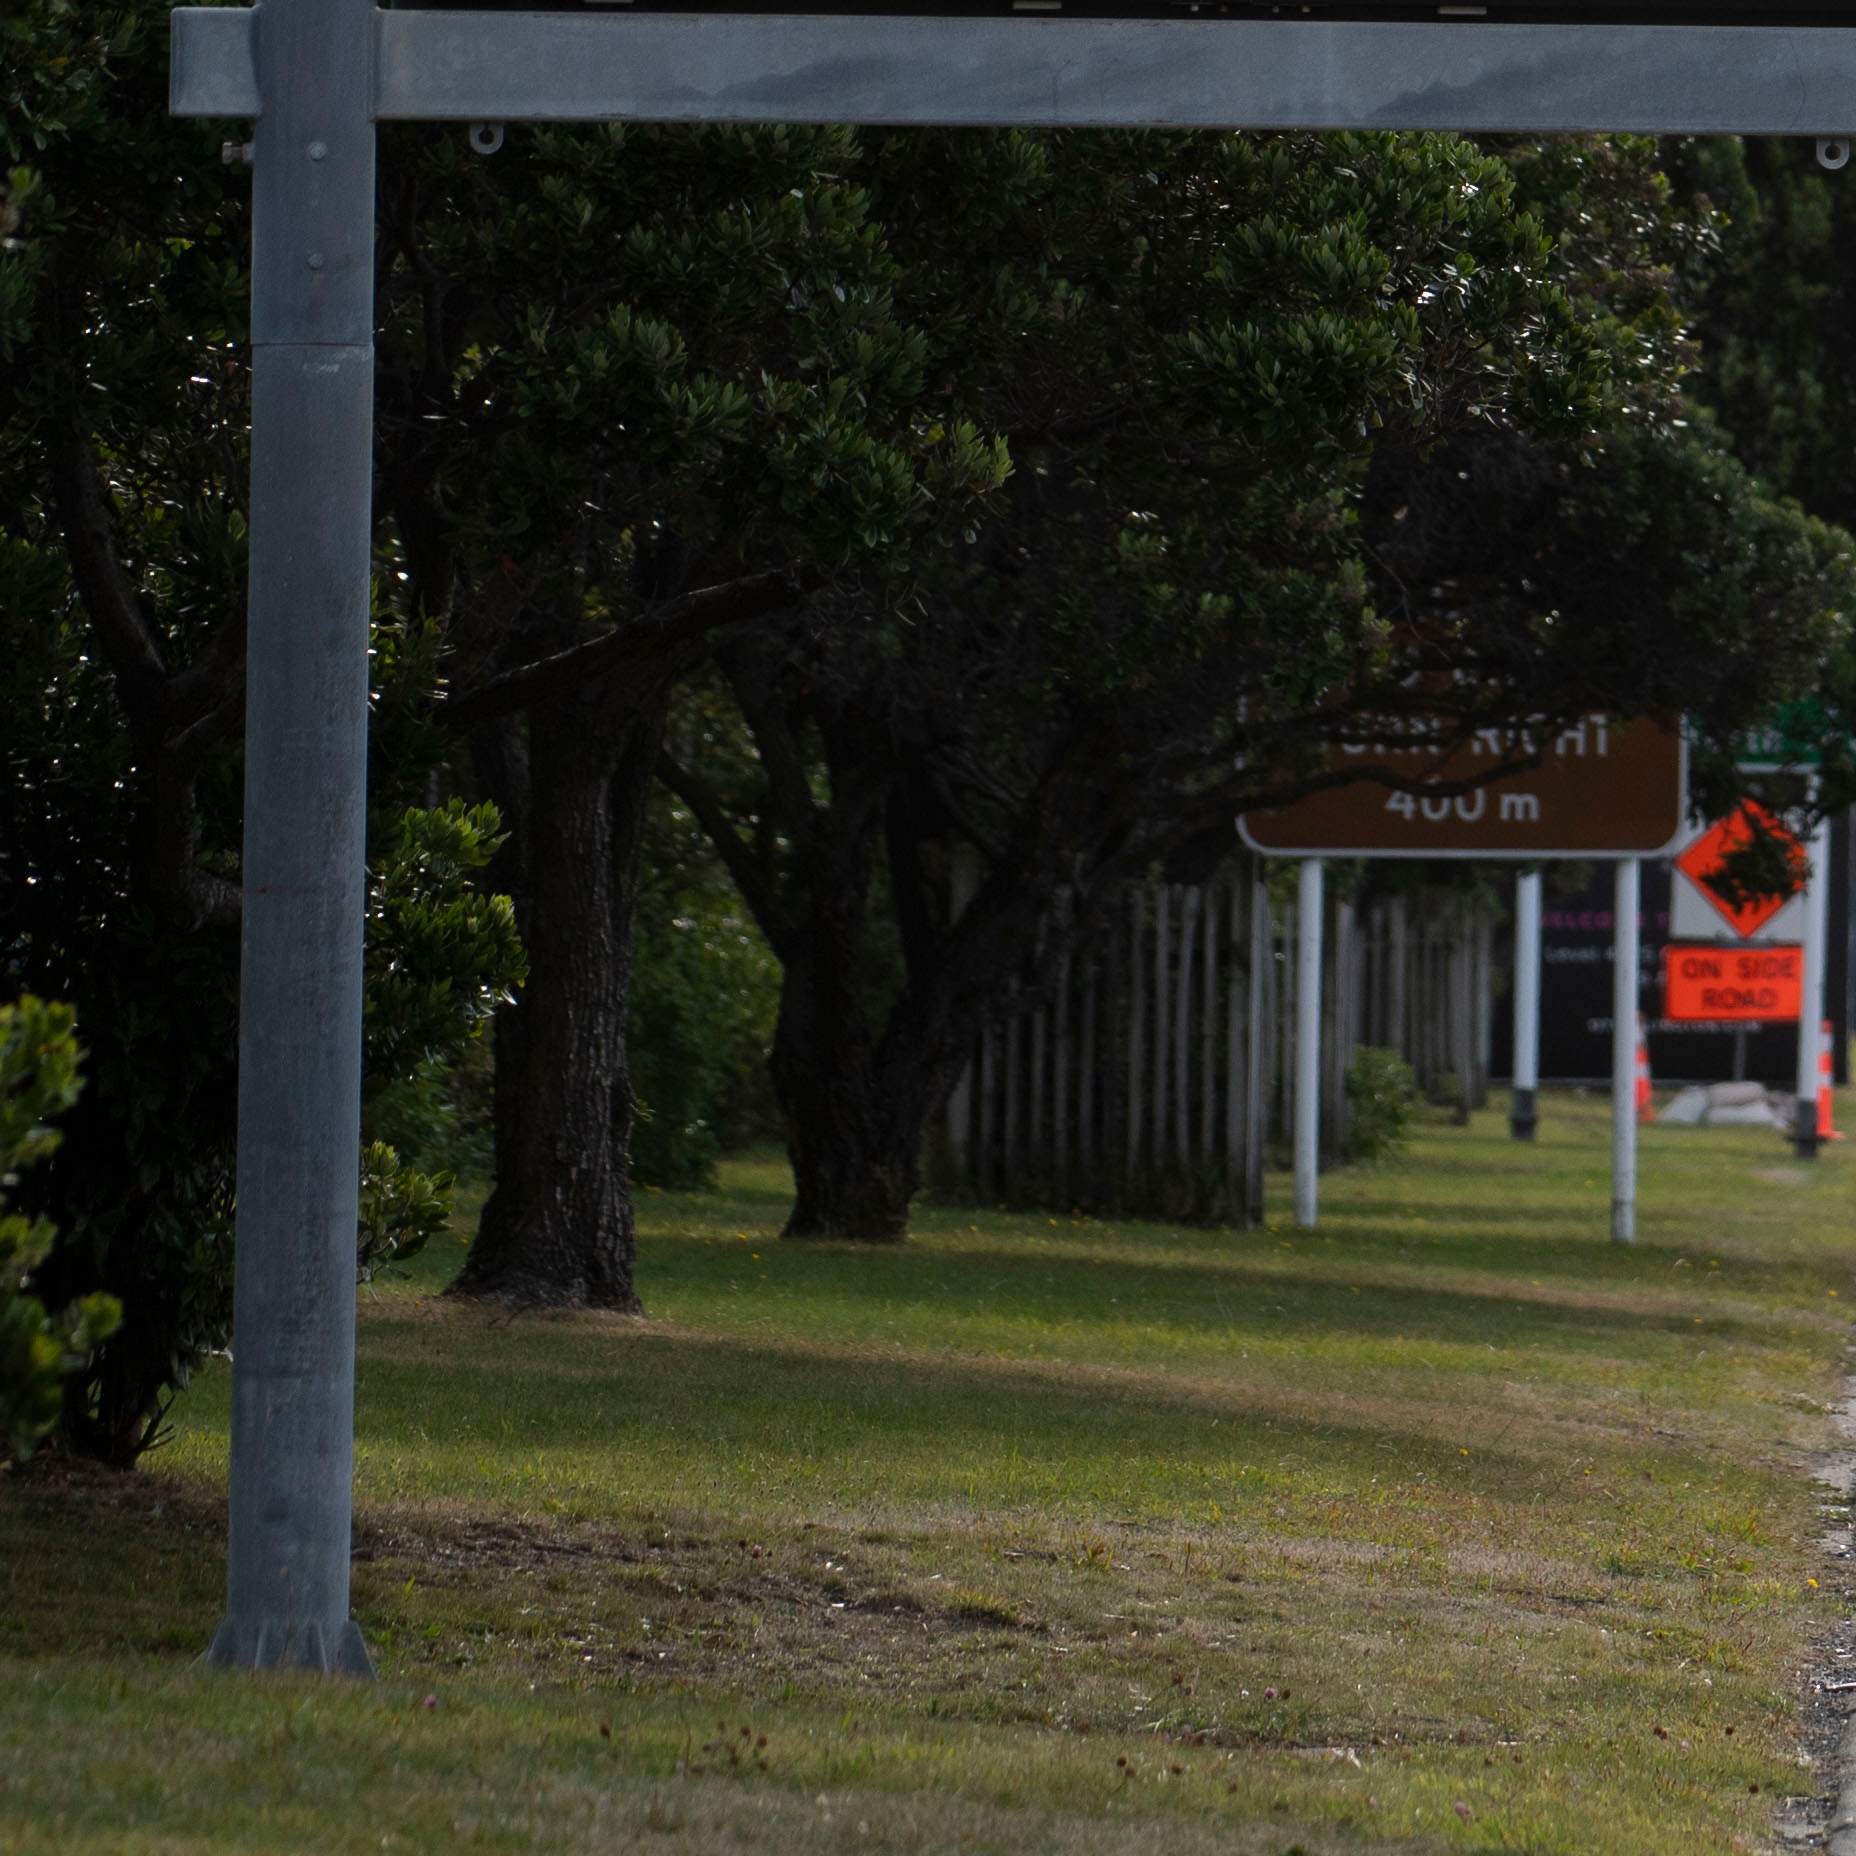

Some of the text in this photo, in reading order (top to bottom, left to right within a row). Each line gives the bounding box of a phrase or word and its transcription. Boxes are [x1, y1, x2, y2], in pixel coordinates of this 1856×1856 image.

[1384, 787, 1541, 822] 400 m
[1681, 957, 1722, 980] ON
[1736, 956, 1796, 981] SIDE
[1701, 987, 1779, 1010] ROAD
